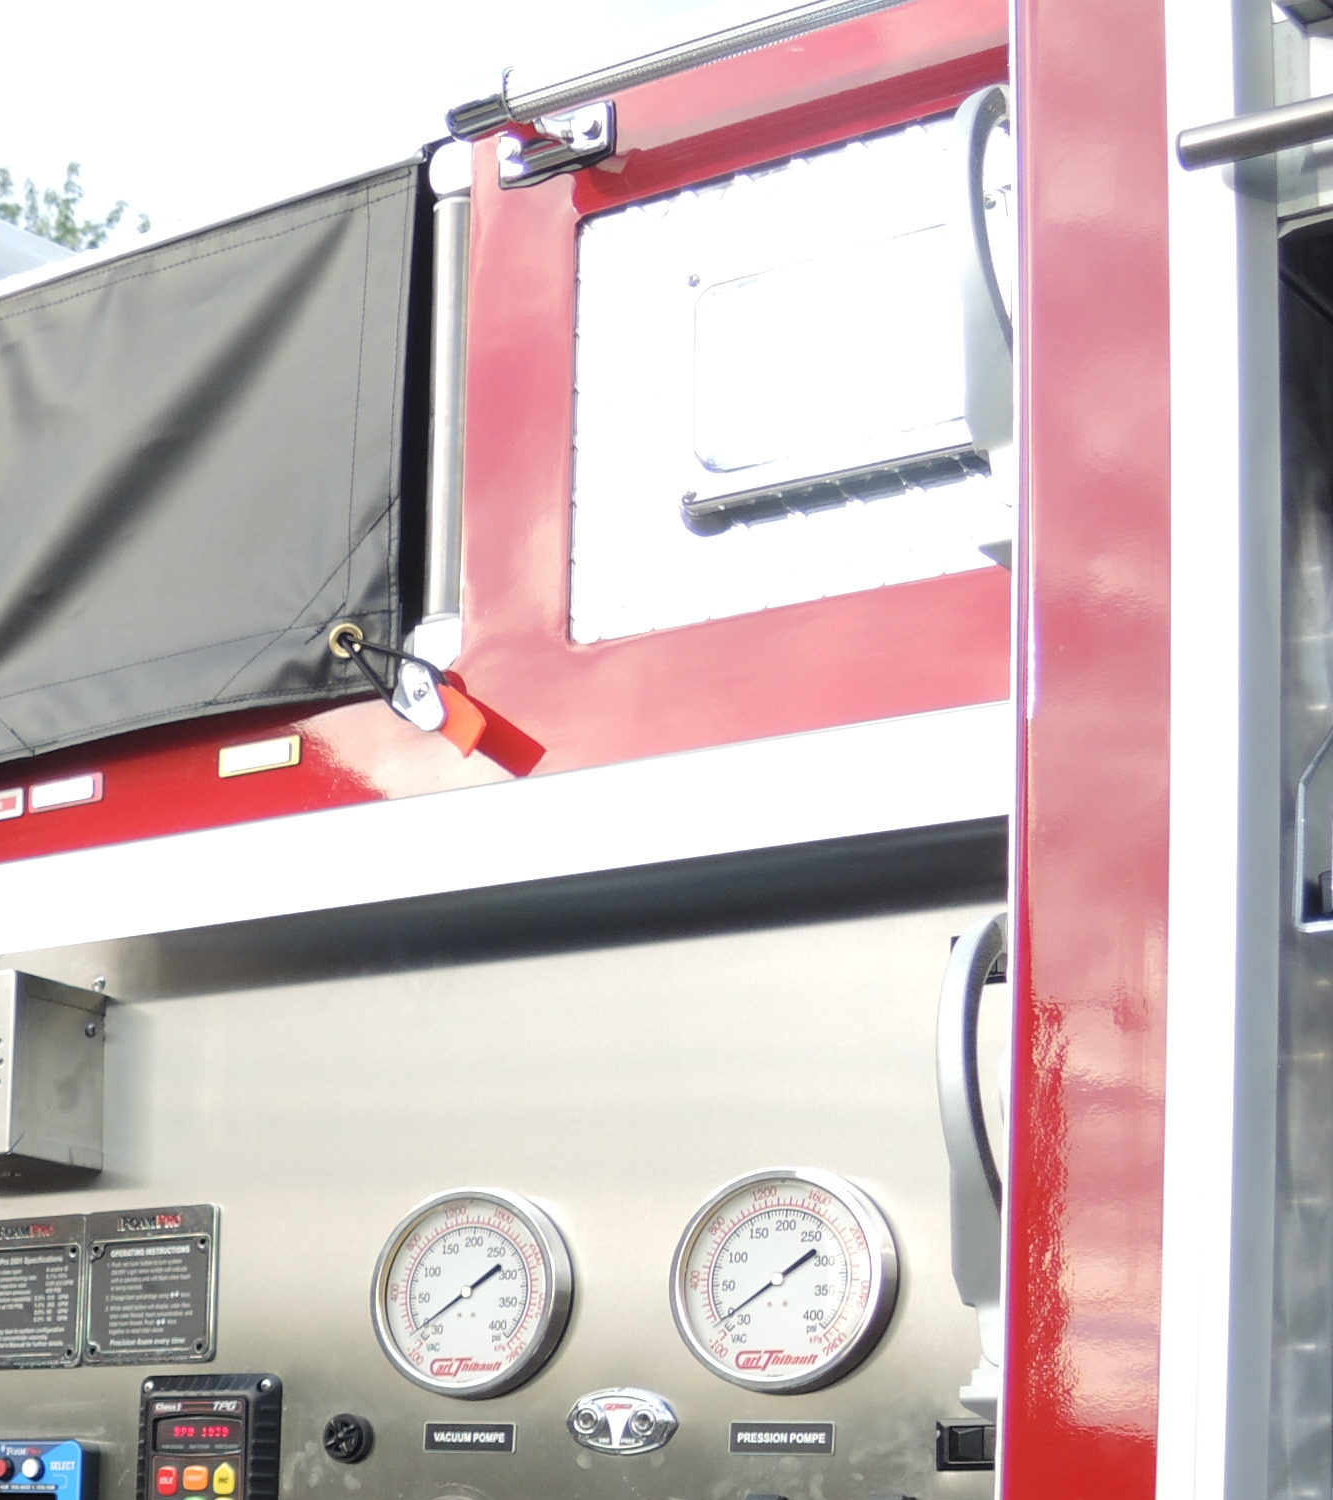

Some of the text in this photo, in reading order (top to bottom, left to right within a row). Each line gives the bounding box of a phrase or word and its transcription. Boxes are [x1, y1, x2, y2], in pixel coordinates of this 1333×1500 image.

[752, 1187, 777, 1201] 1200
[807, 1189, 832, 1206] 1600
[444, 1206, 466, 1219] 1200
[493, 1208, 514, 1224] 1600
[708, 1216, 726, 1236] 800
[776, 1220, 796, 1231] 200
[749, 1228, 768, 1239] 150
[801, 1231, 821, 1242] 250
[406, 1235, 421, 1251] 800
[465, 1237, 483, 1247] 200
[442, 1244, 459, 1255] 150
[486, 1247, 505, 1258] 250
[729, 1252, 748, 1263] 100
[814, 1256, 834, 1266] 300
[424, 1267, 441, 1277] 100
[499, 1270, 517, 1280] 300
[690, 1271, 700, 1290] 400
[722, 1281, 735, 1291] 50
[390, 1284, 400, 1302] 400
[814, 1285, 834, 1296] 350
[418, 1293, 430, 1303] 50
[499, 1297, 517, 1307] 350
[737, 1315, 750, 1325] 30
[803, 1309, 823, 1321] 400
[431, 1324, 444, 1335] 30
[489, 1320, 507, 1330] 400
[806, 1323, 817, 1334] psi
[731, 1334, 747, 1343] VAC
[822, 1333, 847, 1357] 2800
[735, 1350, 818, 1371] Carl Thibault
[430, 1358, 455, 1377] Carl
[434, 1432, 505, 1443] VACUUM POMPE
[737, 1432, 825, 1444] PRESSION POMPE
[50, 1460, 75, 1471] SELECT
